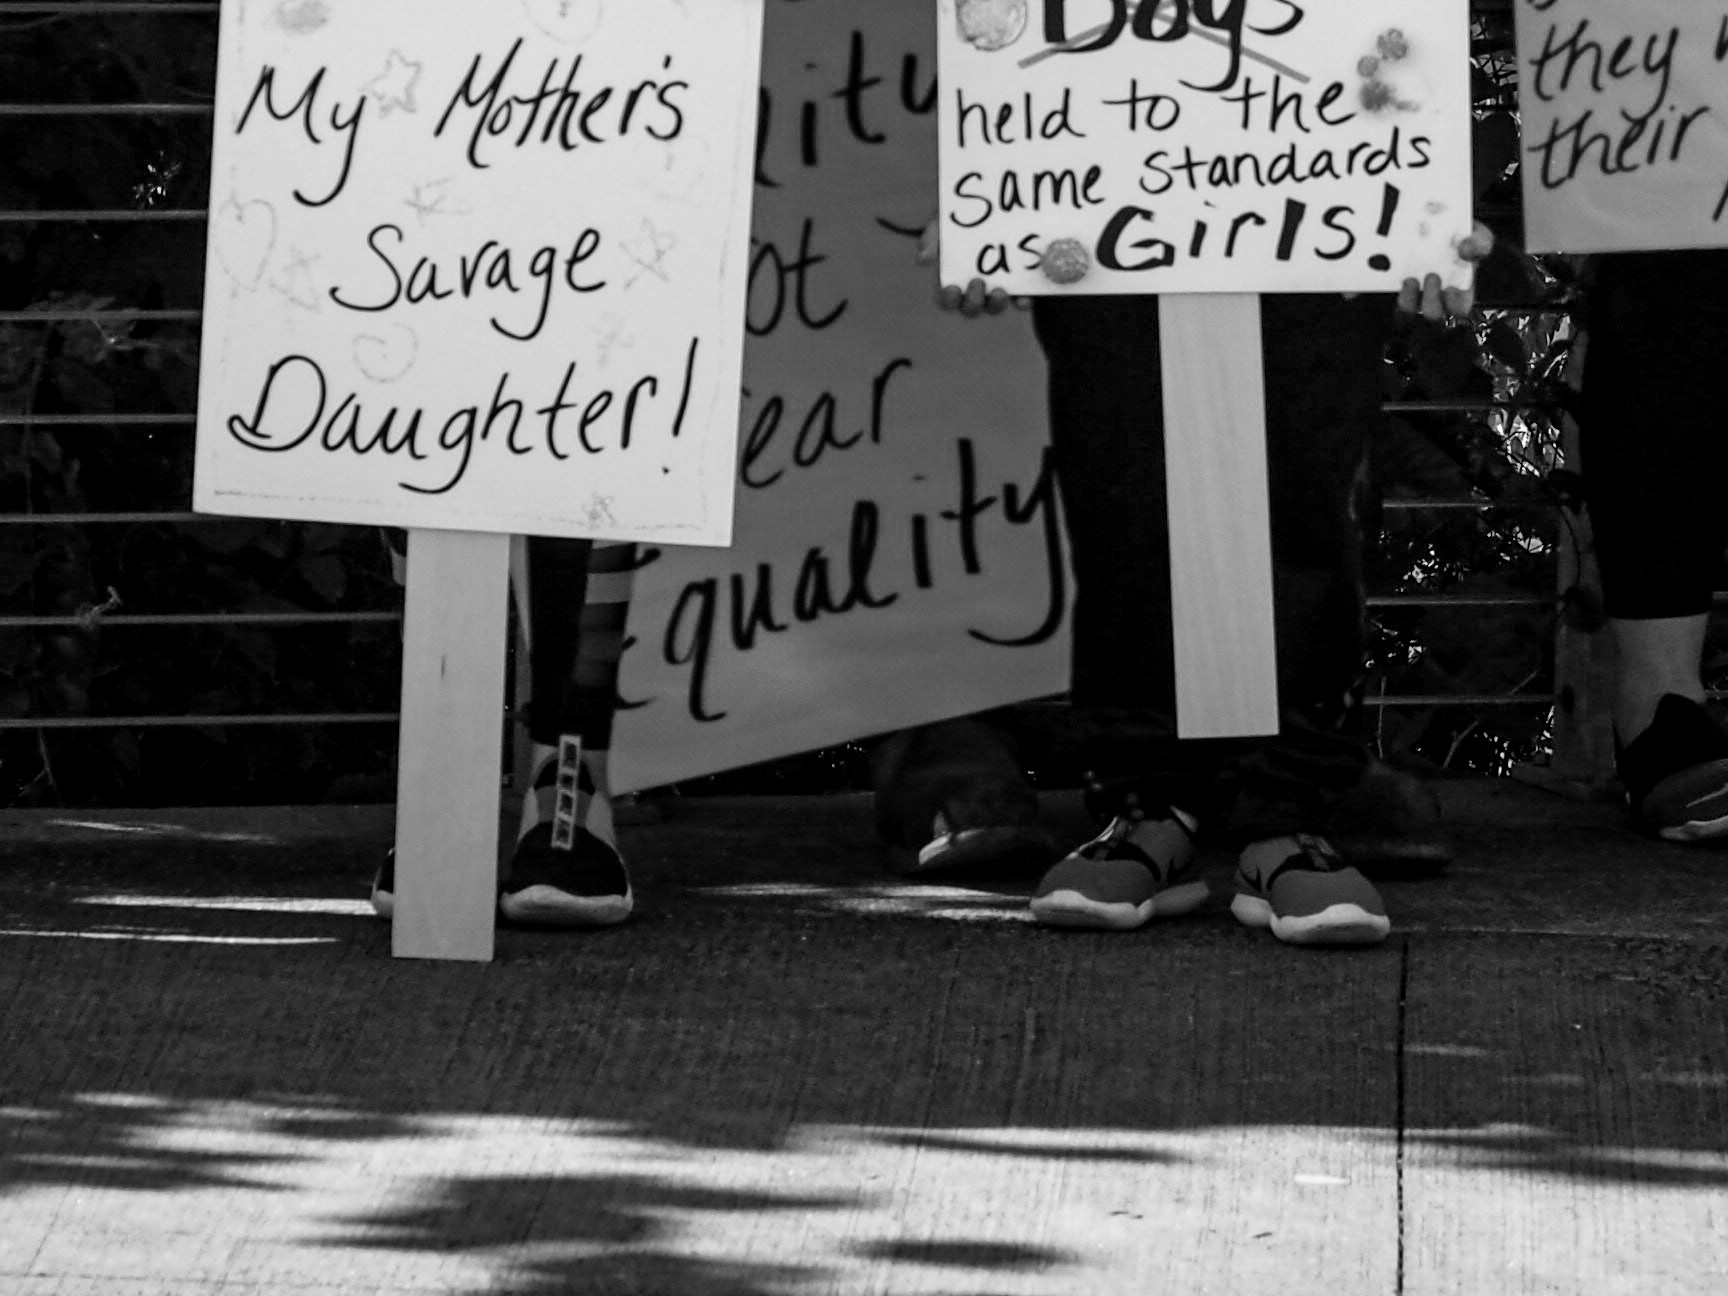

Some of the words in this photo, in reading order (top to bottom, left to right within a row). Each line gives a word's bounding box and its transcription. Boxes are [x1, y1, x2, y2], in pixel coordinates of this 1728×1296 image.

[236, 66, 368, 208] My
[432, 36, 691, 169] Mother's
[956, 86, 1087, 148] held
[1102, 79, 1181, 132] to
[1220, 73, 1358, 134] the
[1529, 19, 1680, 123] they
[950, 161, 1107, 228] same
[1139, 126, 1431, 195] standards
[1528, 106, 1711, 191] their
[328, 222, 607, 340] Savage
[746, 217, 849, 336] ot
[977, 231, 1043, 276] as
[1095, 183, 1401, 271] Girls!
[227, 337, 699, 494] Daughter!
[741, 358, 912, 488] ear
